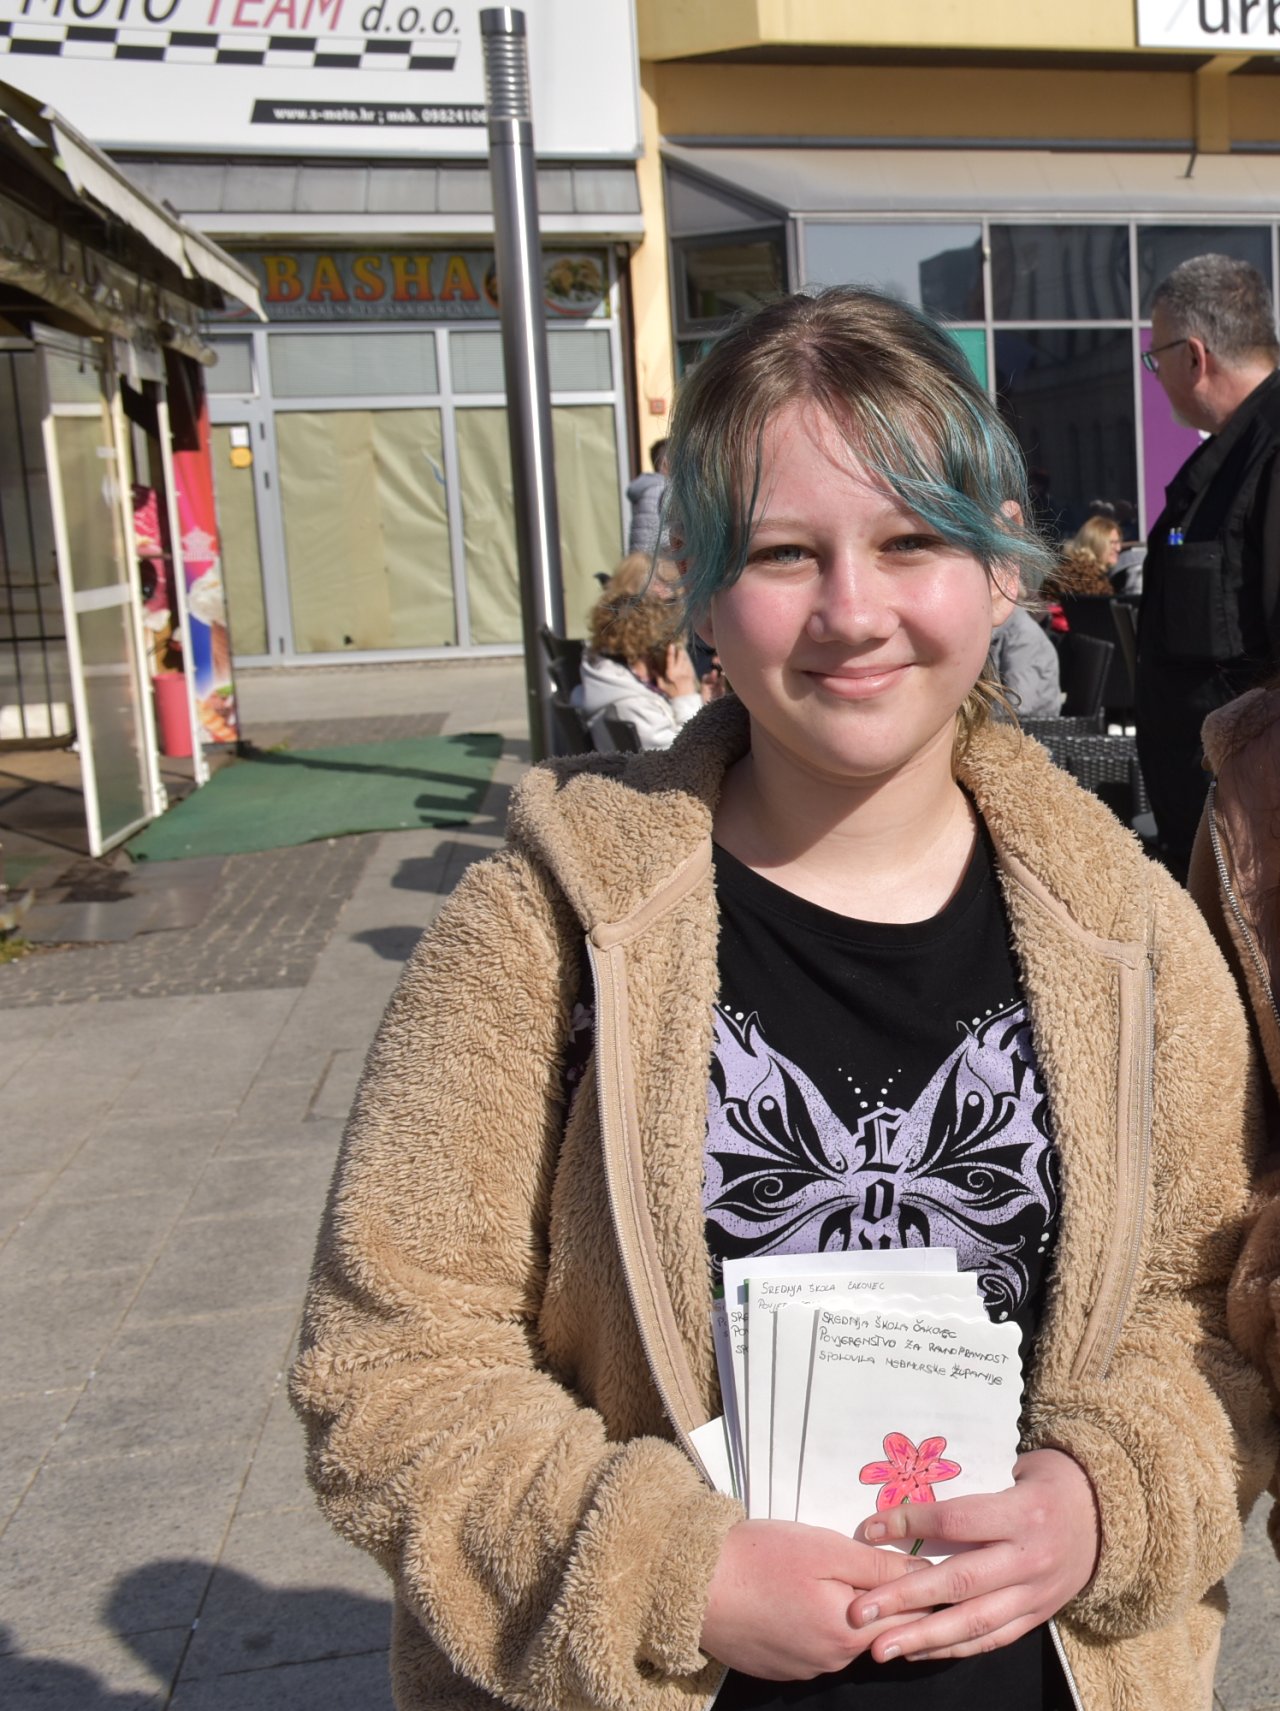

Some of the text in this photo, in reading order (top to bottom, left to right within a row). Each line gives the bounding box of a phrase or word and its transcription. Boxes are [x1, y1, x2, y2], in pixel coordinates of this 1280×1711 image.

[207, 0, 345, 31] TEAM
[361, 0, 460, 34] d.o.o.
[261, 255, 481, 303] BASHA
